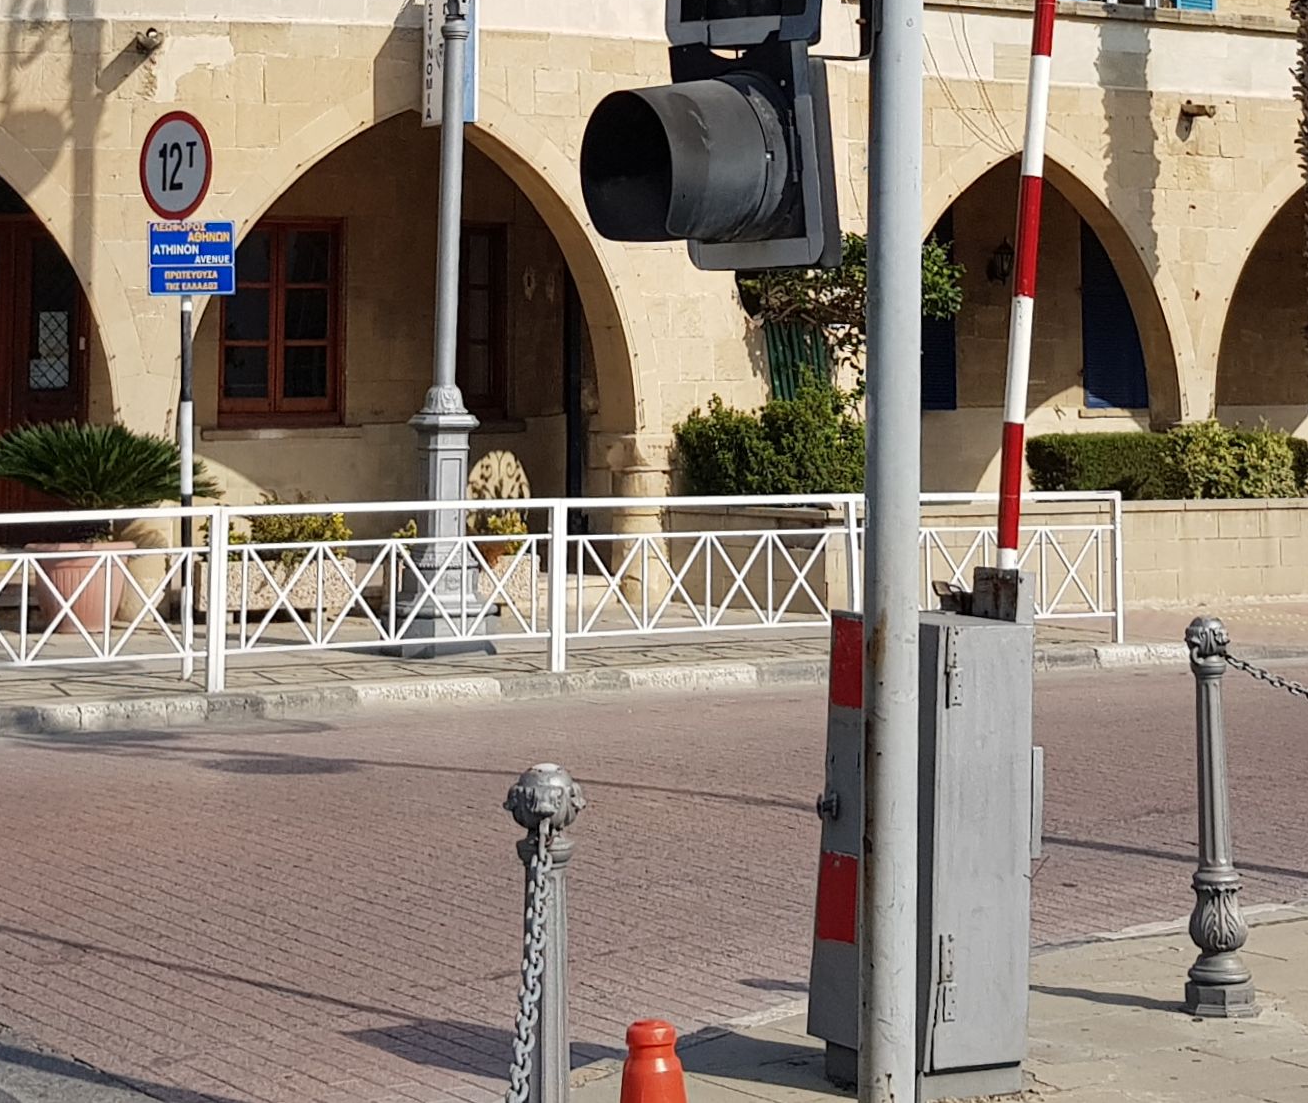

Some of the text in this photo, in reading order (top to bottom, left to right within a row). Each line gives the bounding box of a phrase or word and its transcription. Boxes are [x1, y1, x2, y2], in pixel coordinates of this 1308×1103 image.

[188, 232, 230, 242] ΑΘΗΝΩΝ
[152, 244, 199, 255] ATHINON
[194, 255, 230, 263] AVENUE
